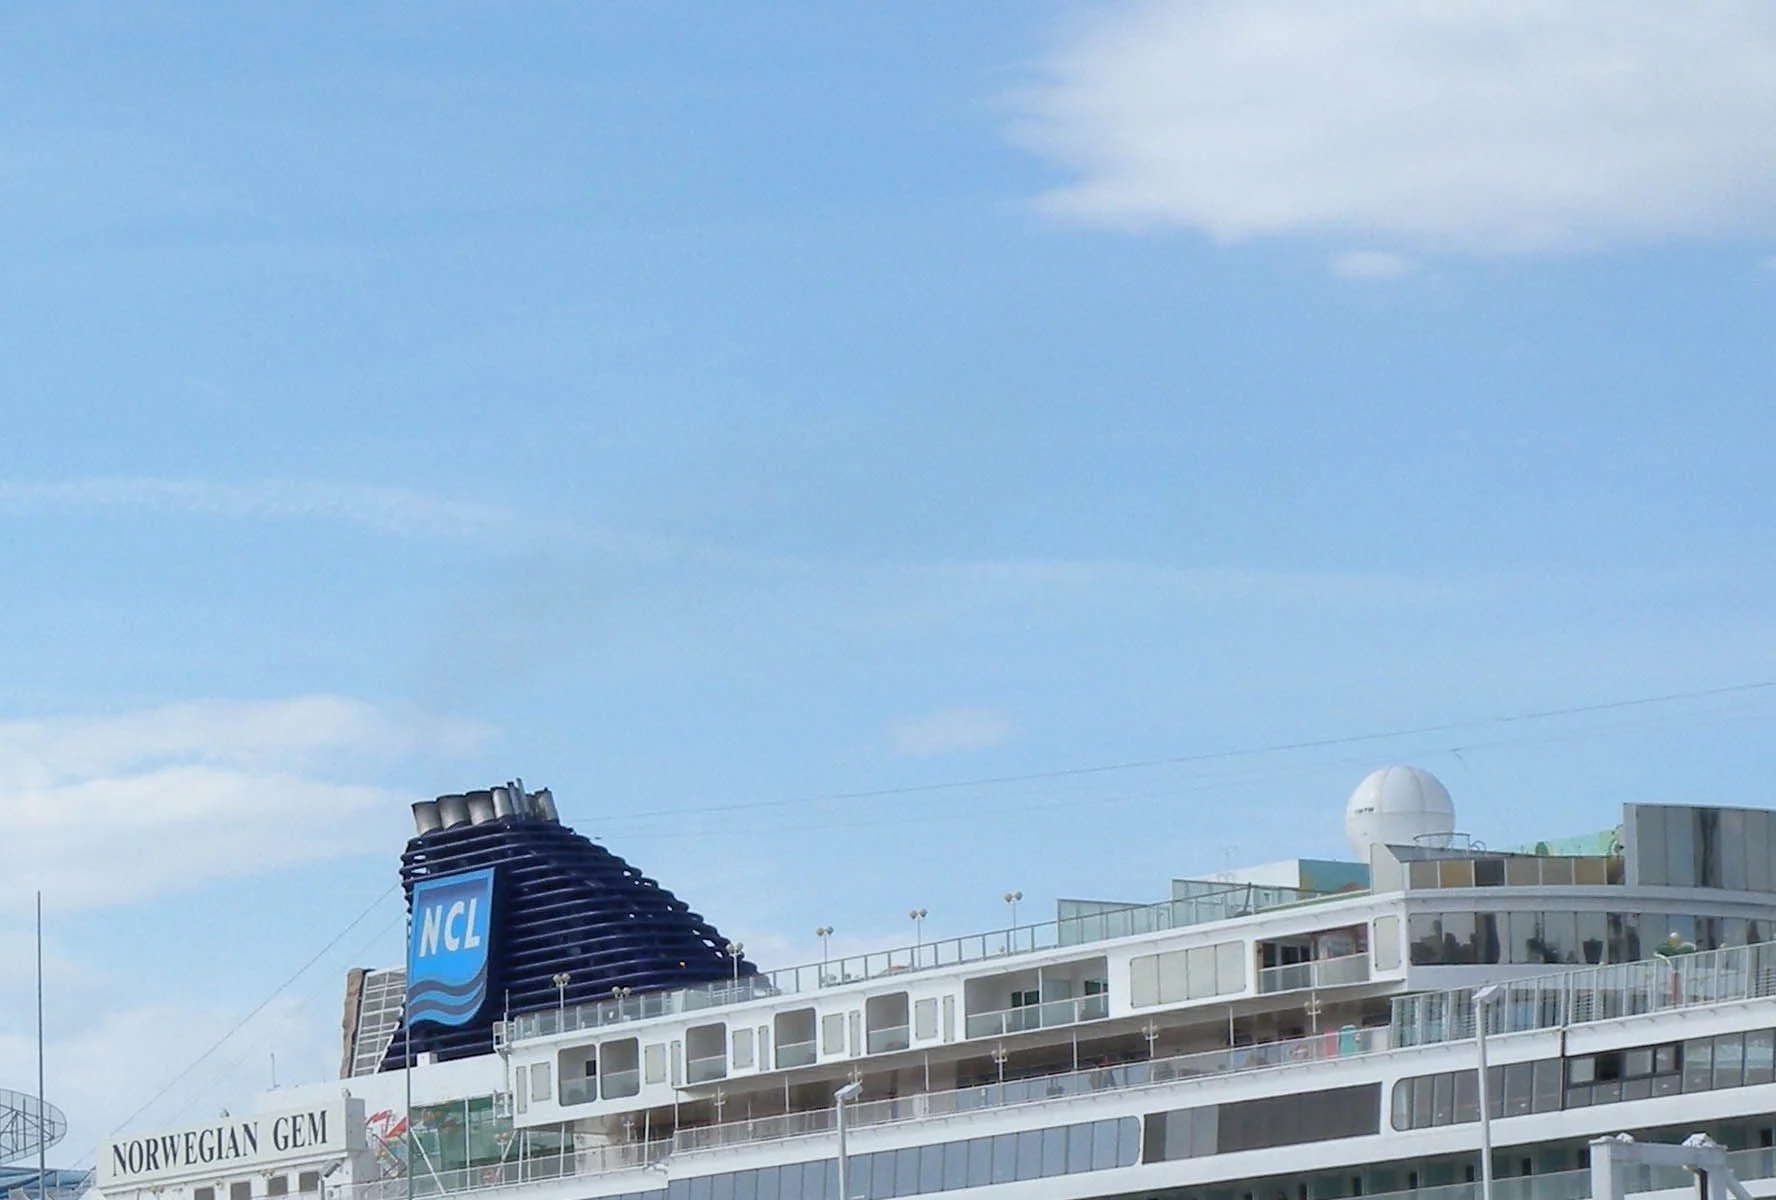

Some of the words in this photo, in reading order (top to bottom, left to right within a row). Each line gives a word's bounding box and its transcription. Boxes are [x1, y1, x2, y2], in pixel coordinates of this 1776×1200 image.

[419, 898, 480, 957] NCL
[112, 1121, 258, 1177] NORWEGIAN
[273, 1110, 327, 1151] GEM
